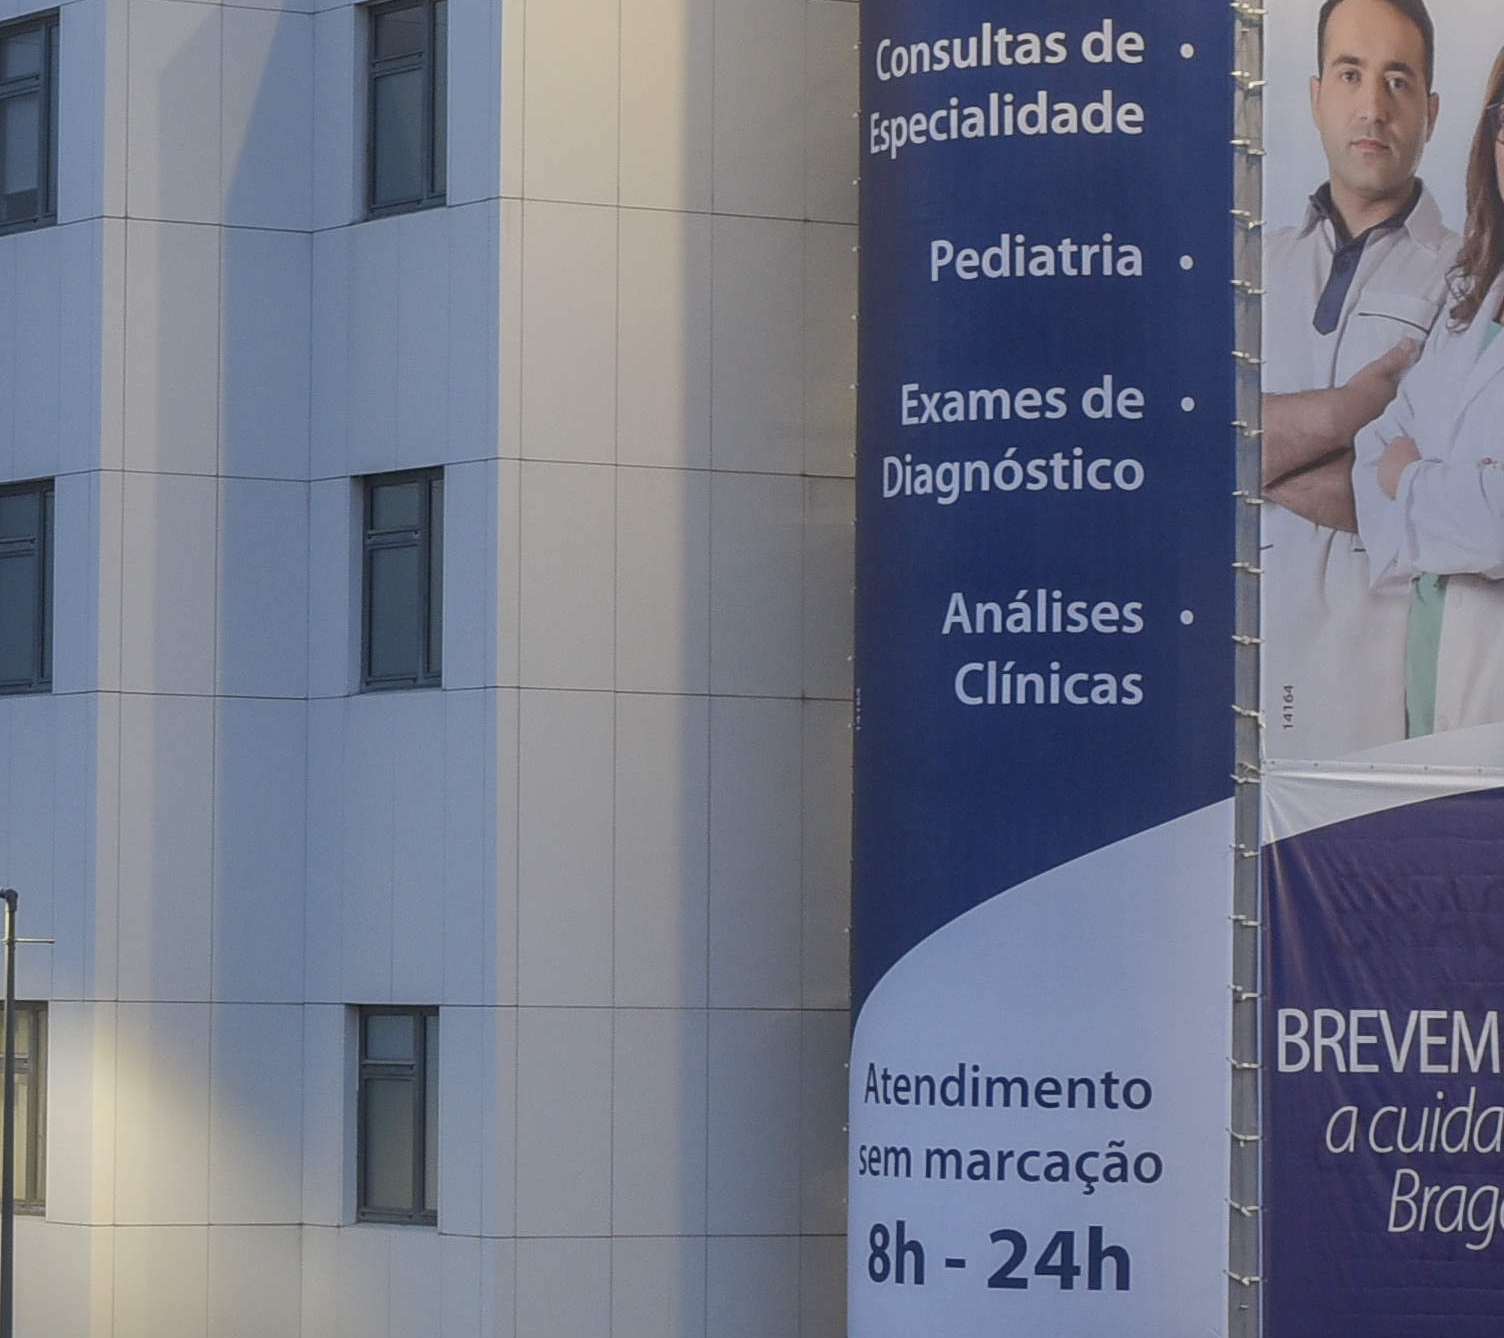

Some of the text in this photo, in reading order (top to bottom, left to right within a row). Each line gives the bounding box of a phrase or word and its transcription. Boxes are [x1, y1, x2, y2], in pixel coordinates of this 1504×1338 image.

[875, 18, 1145, 82] Consultas de
[869, 89, 1145, 160] Especialidade
[930, 232, 1143, 282] Pediatria
[900, 374, 1145, 426] Exames de
[882, 447, 1145, 505] Diagnóstico
[941, 588, 1145, 635] Análises
[954, 659, 1144, 706] Clínicas
[1282, 684, 1294, 730] 14164
[864, 1062, 1153, 1110] Atendimento
[1325, 1105, 1358, 1154] a
[858, 1139, 1164, 1196] sem marcação
[868, 1219, 926, 1287] 8h
[987, 1225, 1132, 1291] 24h
